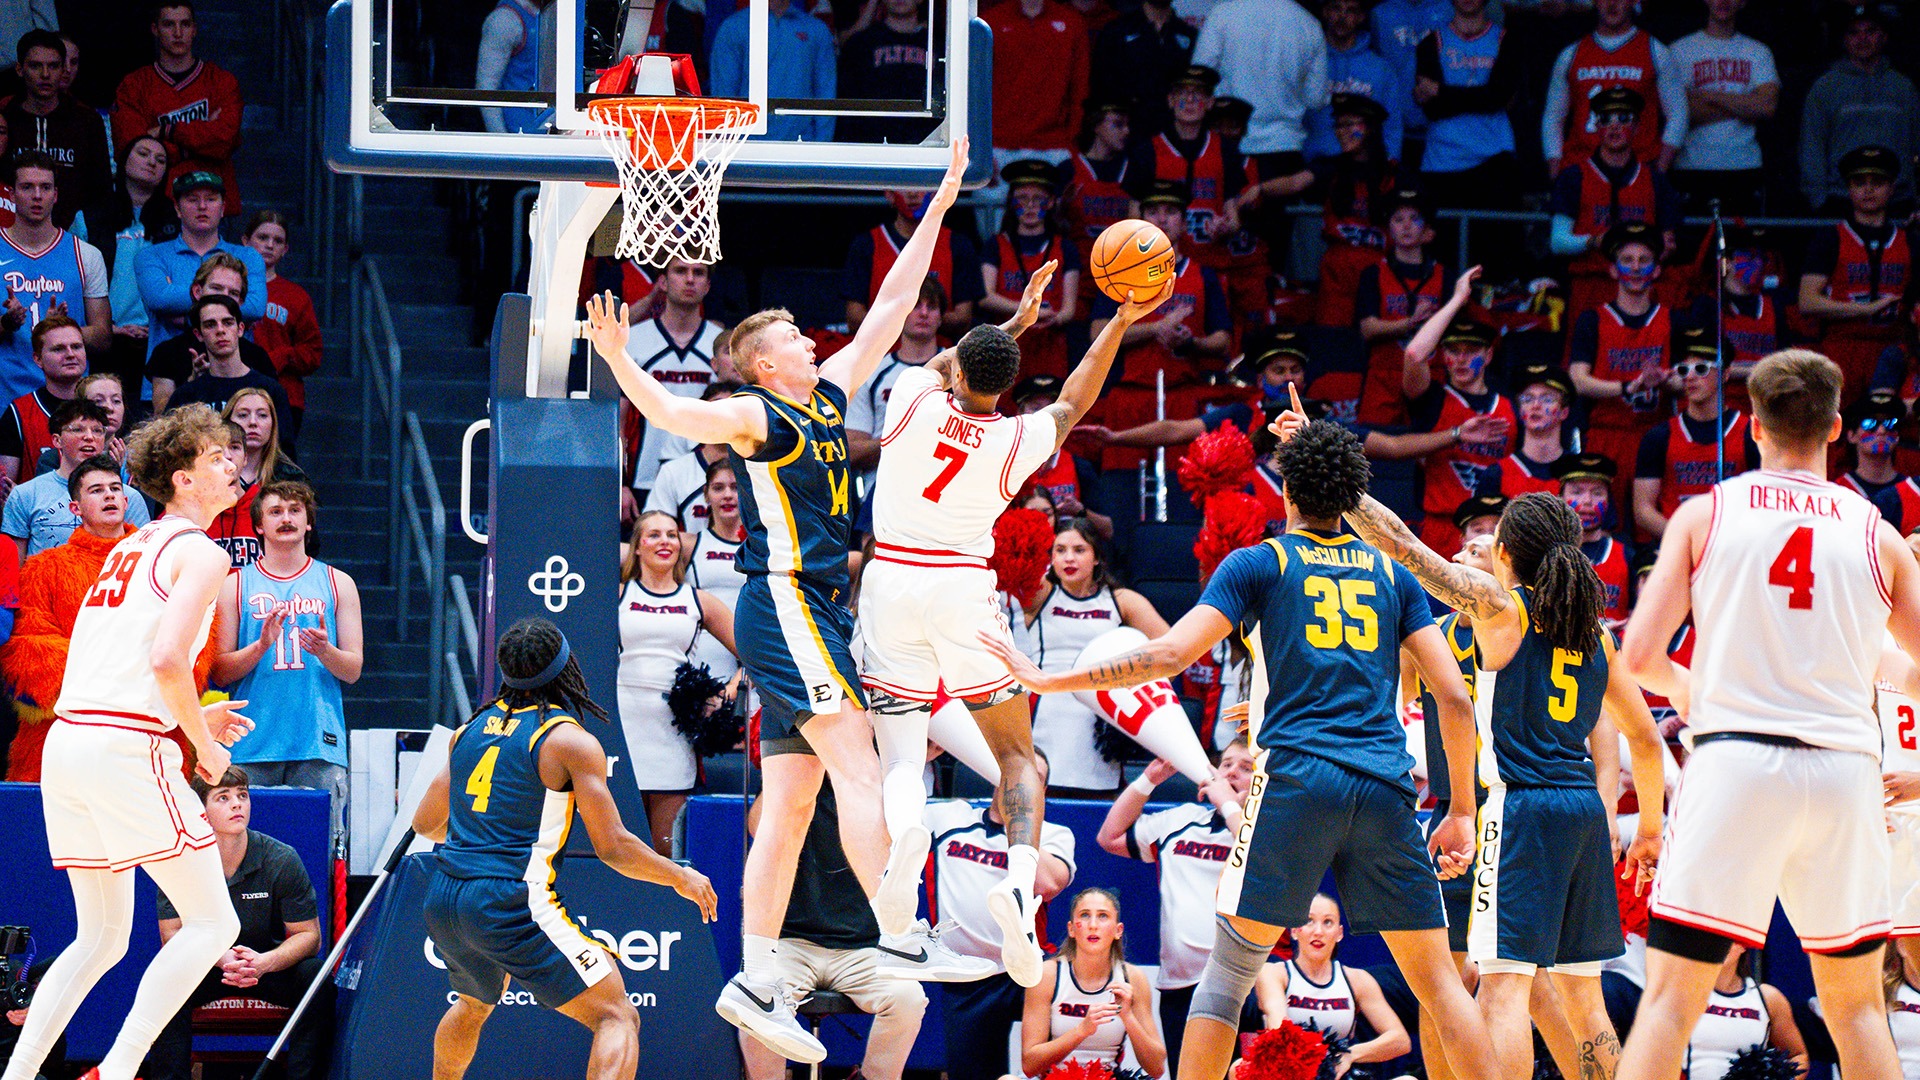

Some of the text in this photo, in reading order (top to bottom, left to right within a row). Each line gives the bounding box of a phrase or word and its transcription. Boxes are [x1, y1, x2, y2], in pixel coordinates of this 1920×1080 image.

[1577, 65, 1643, 82] DAYTON
[160, 101, 208, 126] DAYTON
[4, 271, 65, 299] Dayton
[652, 370, 712, 385] DAYTON
[938, 414, 985, 449] JONES
[921, 441, 969, 504] 7
[1749, 484, 1844, 521] DERKACK
[1295, 546, 1375, 573] McCULLUM
[1769, 526, 1815, 610] 4
[85, 551, 142, 608] 29
[630, 601, 688, 615] DAYTON
[1052, 606, 1112, 620] DAYTON
[1304, 576, 1379, 653] 35
[273, 627, 305, 671] 11
[1548, 646, 1584, 723] 5
[1897, 704, 1917, 751] 2
[465, 746, 500, 813] 4
[1231, 775, 1264, 868] BUCS
[1476, 820, 1499, 912] BUCS
[241, 892, 269, 900] FLYERS
[1287, 994, 1350, 1011] DAYTON
